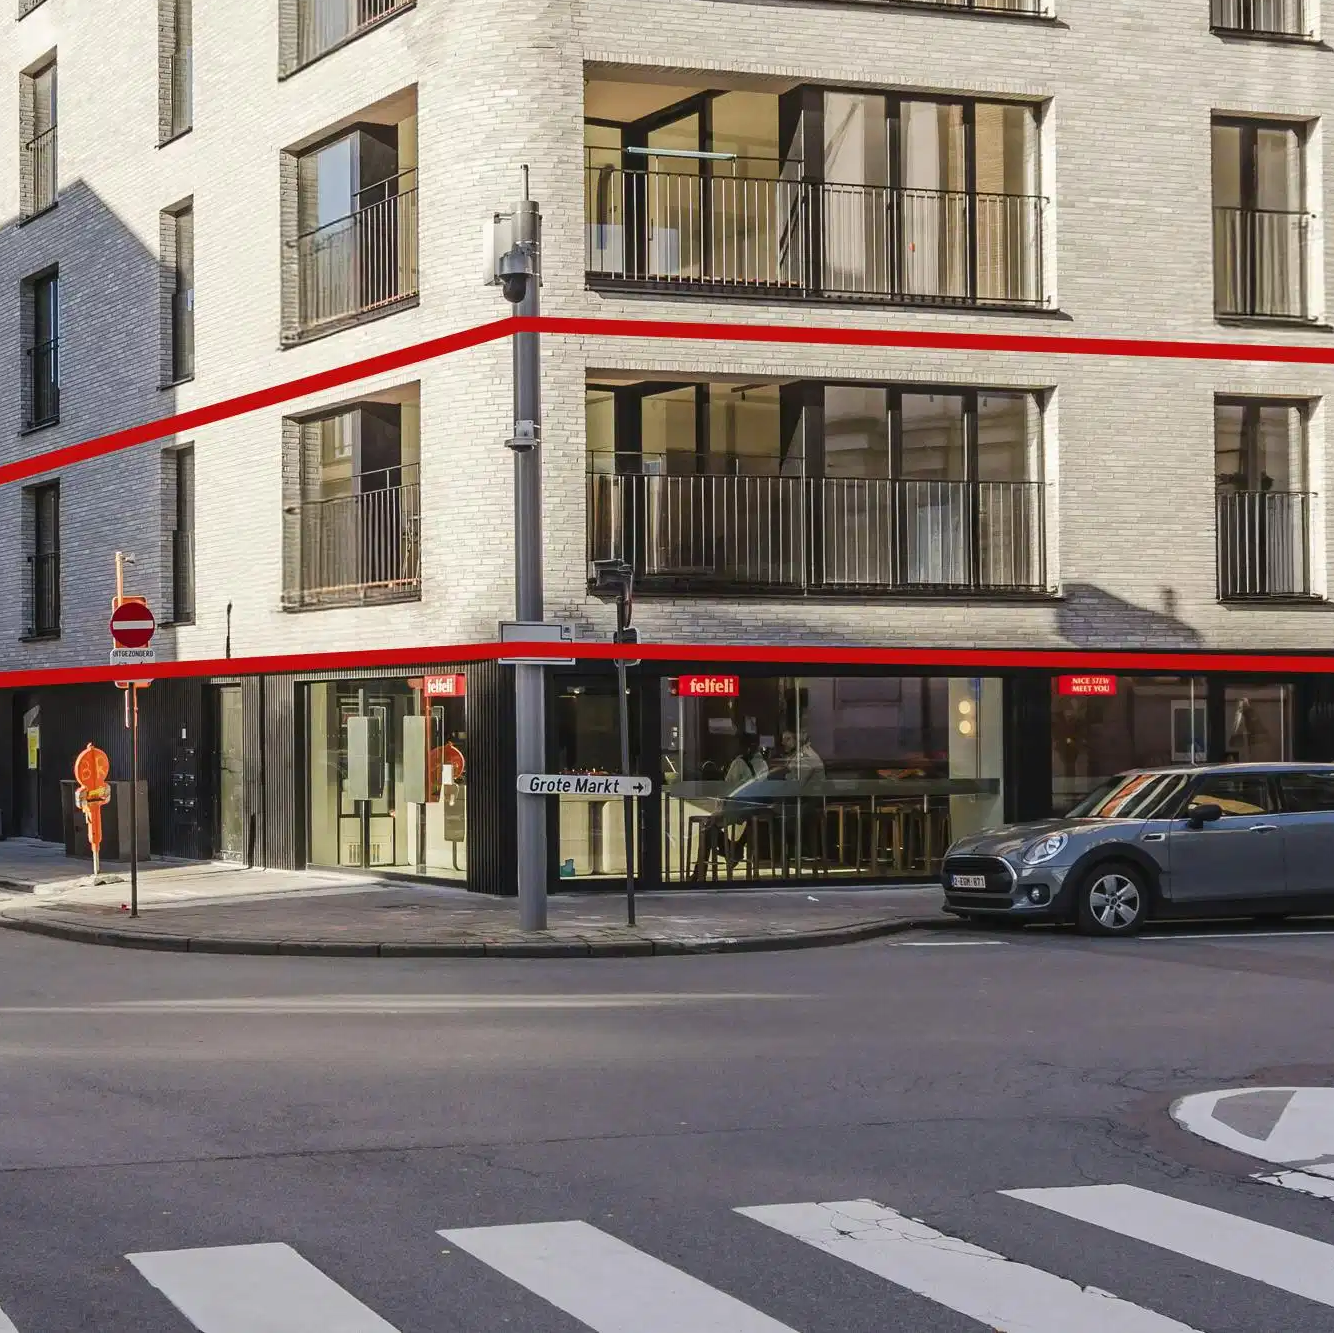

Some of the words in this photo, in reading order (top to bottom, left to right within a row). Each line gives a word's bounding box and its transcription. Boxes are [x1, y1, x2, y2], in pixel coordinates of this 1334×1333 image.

[113, 650, 154, 658] UITGEZONDERD
[428, 677, 453, 694] felfeli
[690, 678, 734, 693] felfeli
[529, 776, 571, 792] Grote
[574, 777, 620, 793] Markt
